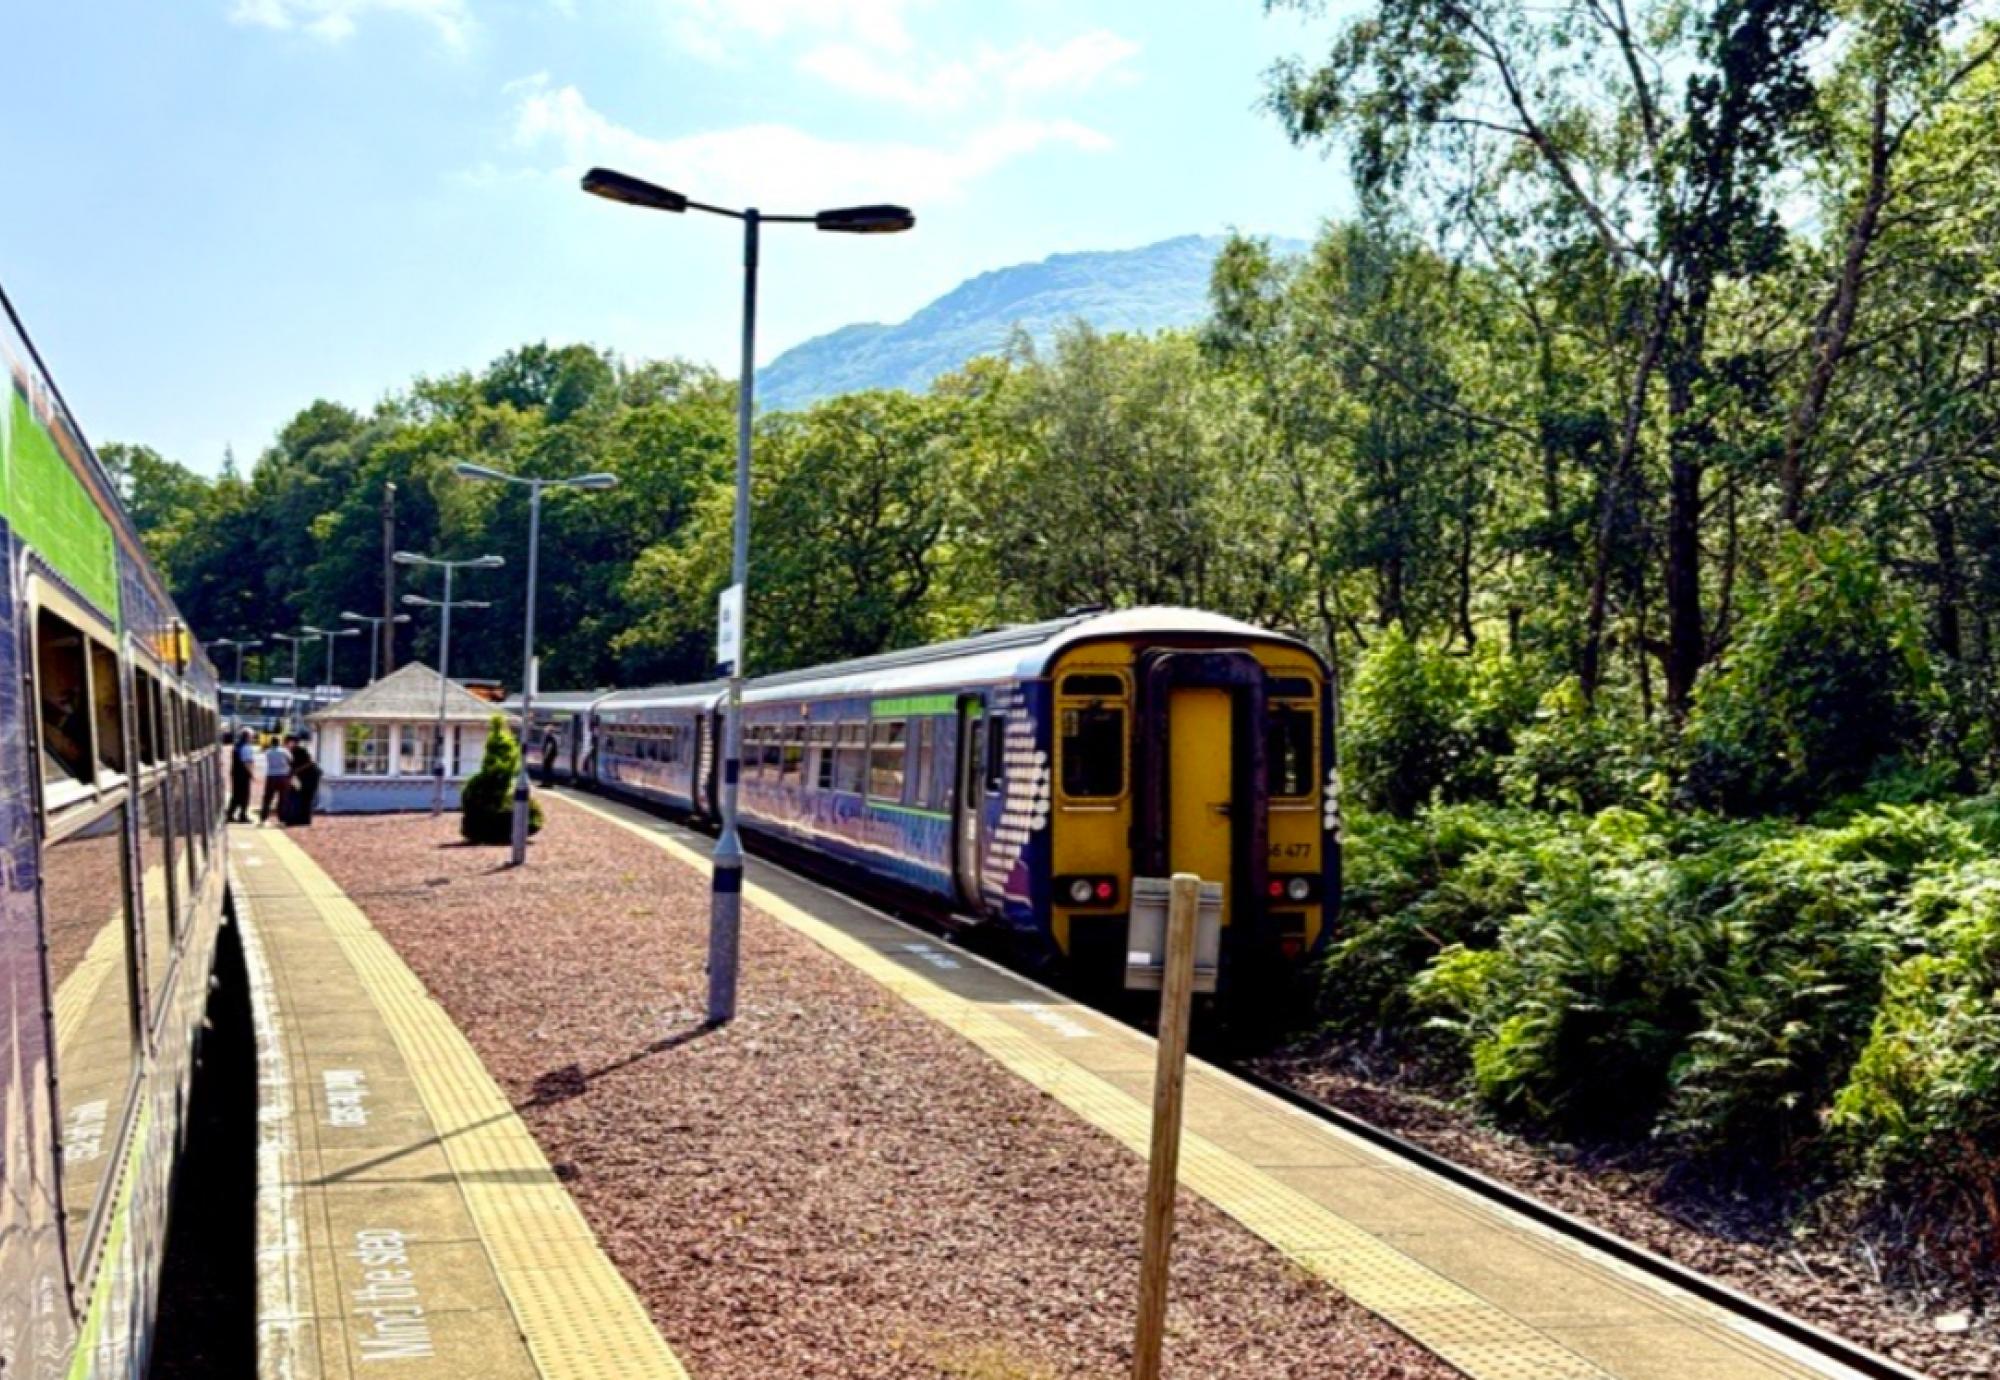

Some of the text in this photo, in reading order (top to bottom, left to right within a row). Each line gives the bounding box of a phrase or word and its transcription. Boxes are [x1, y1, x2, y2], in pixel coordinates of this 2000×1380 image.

[1286, 843, 1312, 859] 477
[346, 1230, 436, 1360] Mind the step
